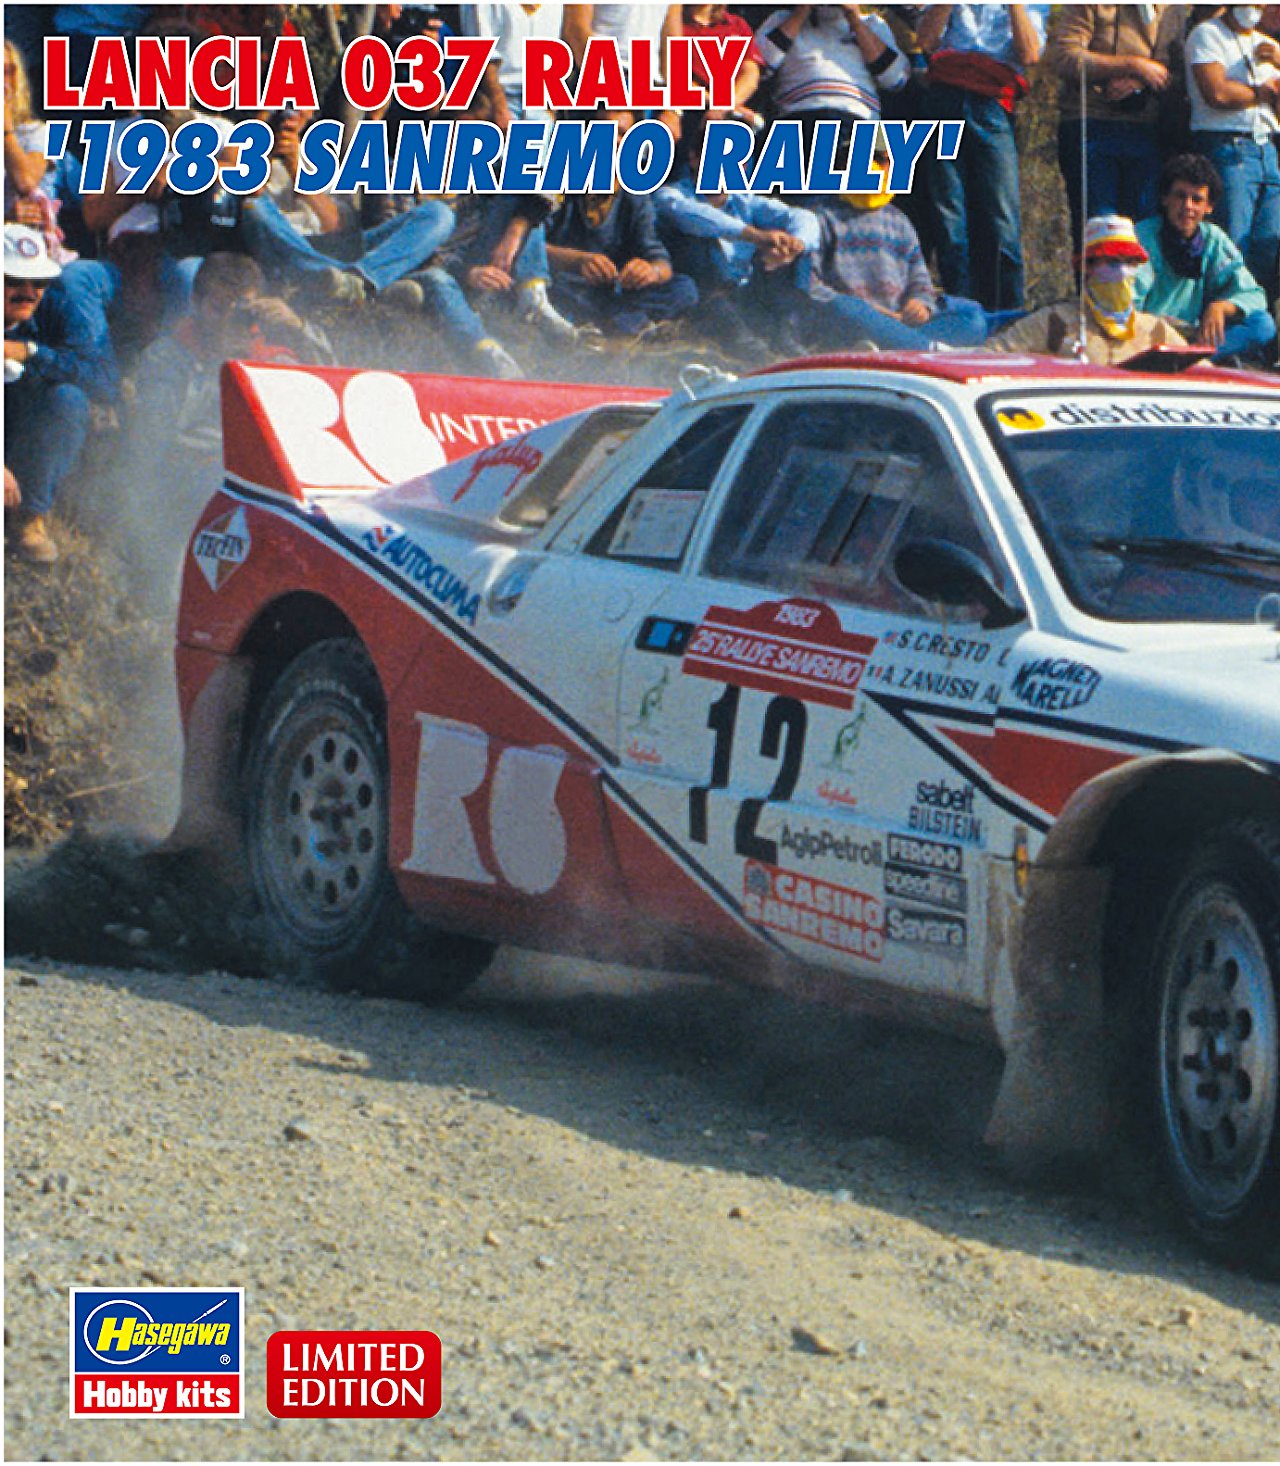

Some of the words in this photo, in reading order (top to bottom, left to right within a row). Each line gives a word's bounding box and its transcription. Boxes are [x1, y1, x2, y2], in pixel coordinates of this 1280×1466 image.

[381, 533, 482, 625] AUTOCLIMA
[774, 605, 820, 629] 1983
[774, 647, 862, 685] SANREMO
[1011, 657, 1103, 690] MAGNETI
[1015, 680, 1101, 710] MARELLI
[689, 683, 808, 865] 12
[917, 780, 975, 813] sabelt
[909, 805, 982, 842] BILSTEIN
[782, 825, 884, 866] AgipPetroli
[890, 836, 959, 870] FERODO
[775, 873, 885, 928] CASINO
[744, 894, 885, 960] SANREMO
[888, 907, 964, 944] Savara
